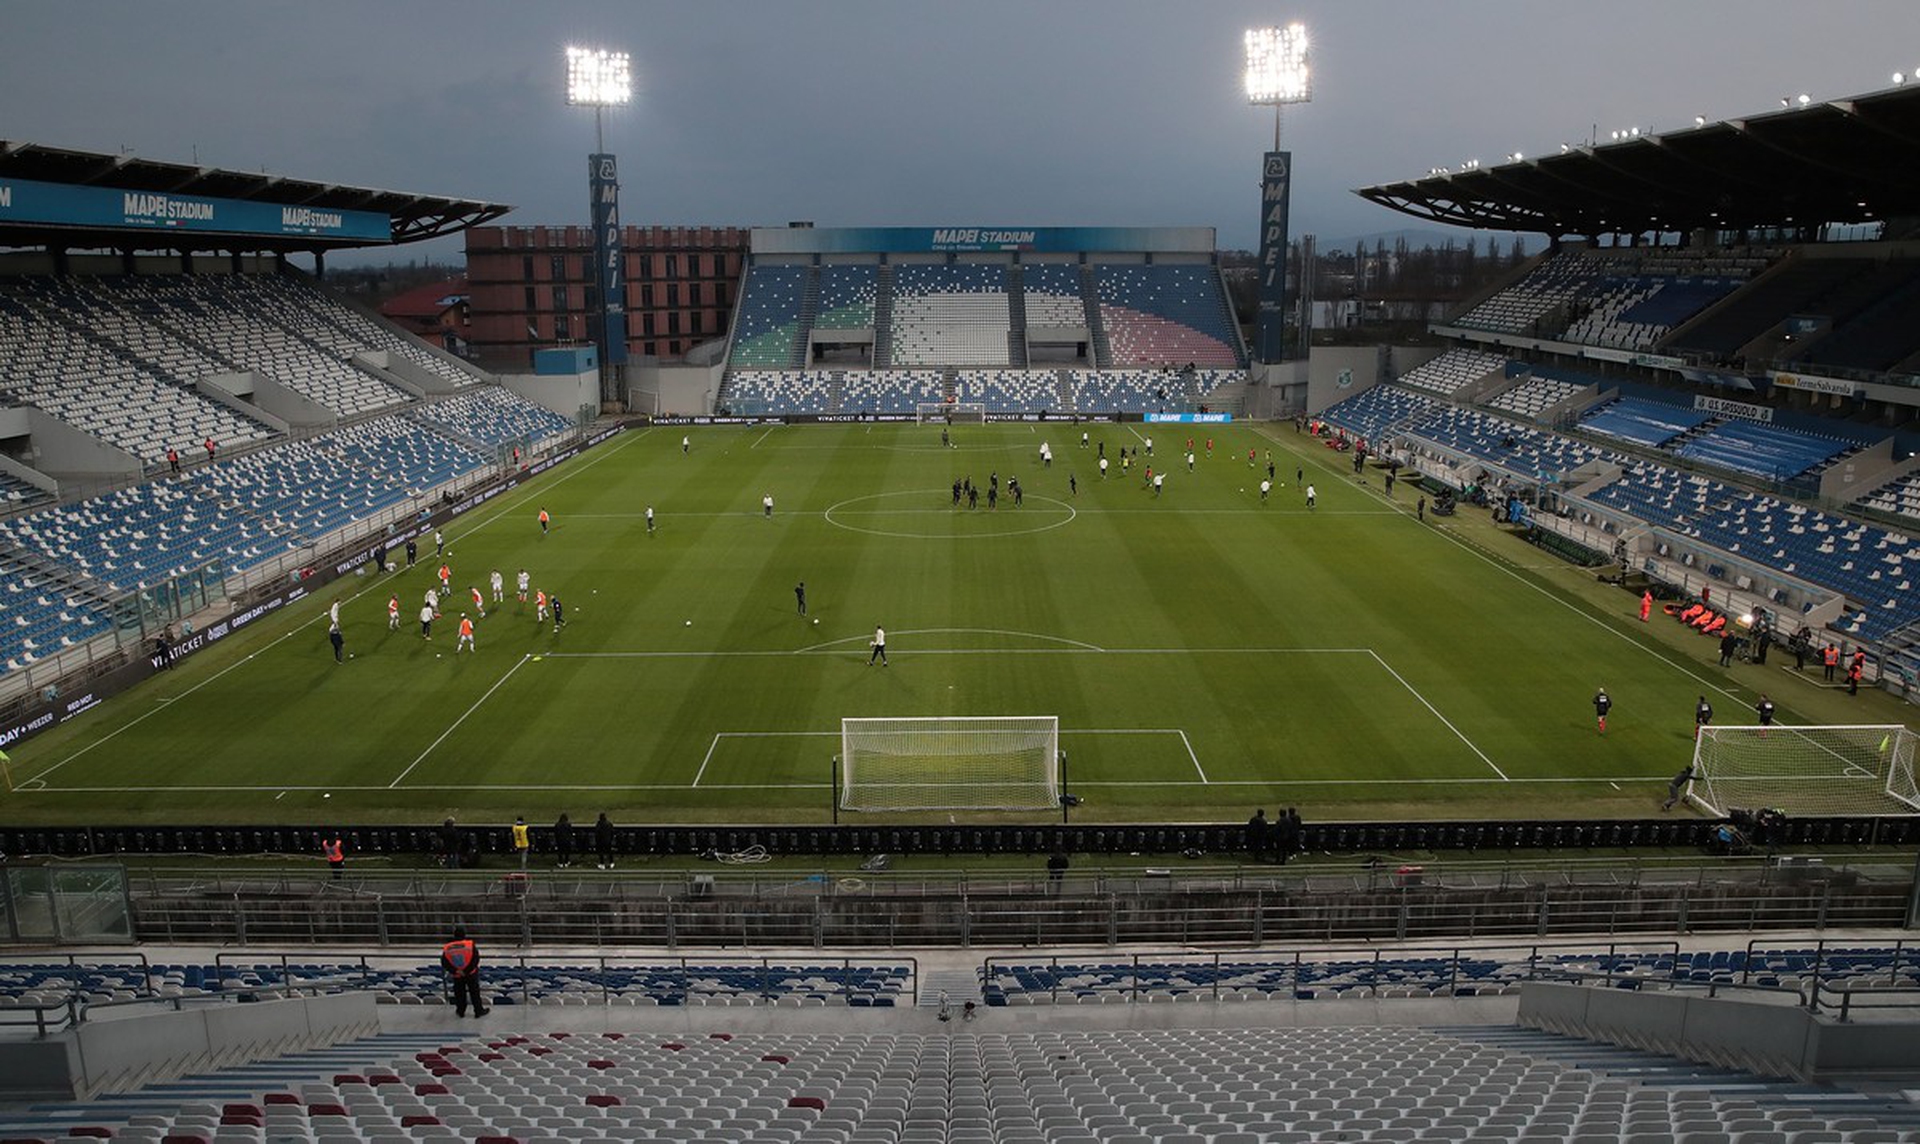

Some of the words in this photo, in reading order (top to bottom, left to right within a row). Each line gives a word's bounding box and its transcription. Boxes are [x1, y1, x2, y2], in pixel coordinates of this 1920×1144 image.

[125, 193, 167, 217] MAPEI
[168, 201, 213, 219] STADIUM
[283, 207, 311, 226] MAPEI
[311, 212, 342, 228] STADIUM
[602, 185, 617, 289] MAPEI
[933, 229, 979, 243] MAPEI
[980, 231, 1035, 243] STADIUM
[1264, 182, 1285, 287] MAPEI
[231, 611, 252, 628] GREEN
[151, 634, 204, 668] VIATICKET
[0, 727, 20, 747] DAY
